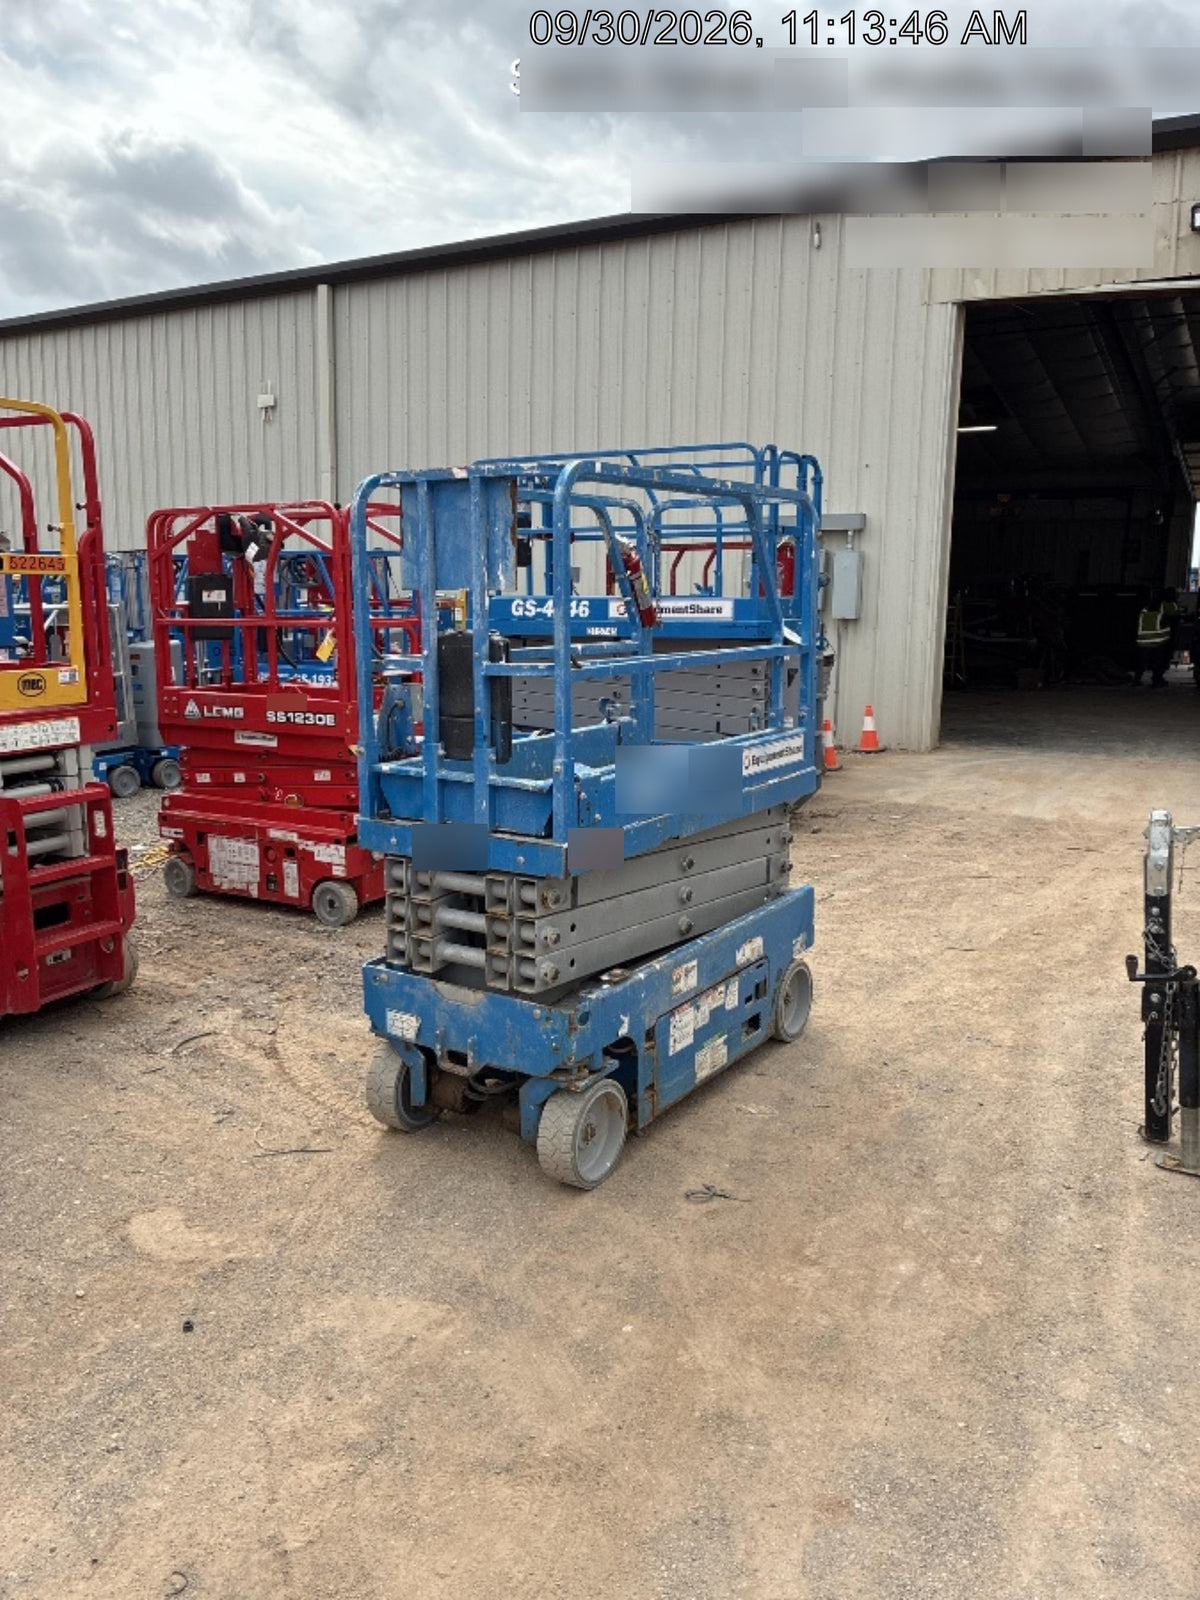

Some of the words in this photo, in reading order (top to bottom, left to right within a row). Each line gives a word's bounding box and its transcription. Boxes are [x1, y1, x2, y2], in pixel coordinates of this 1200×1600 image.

[9, 556, 66, 571] 522645
[511, 598, 590, 618] GS-446
[266, 710, 336, 726] SS1230E
